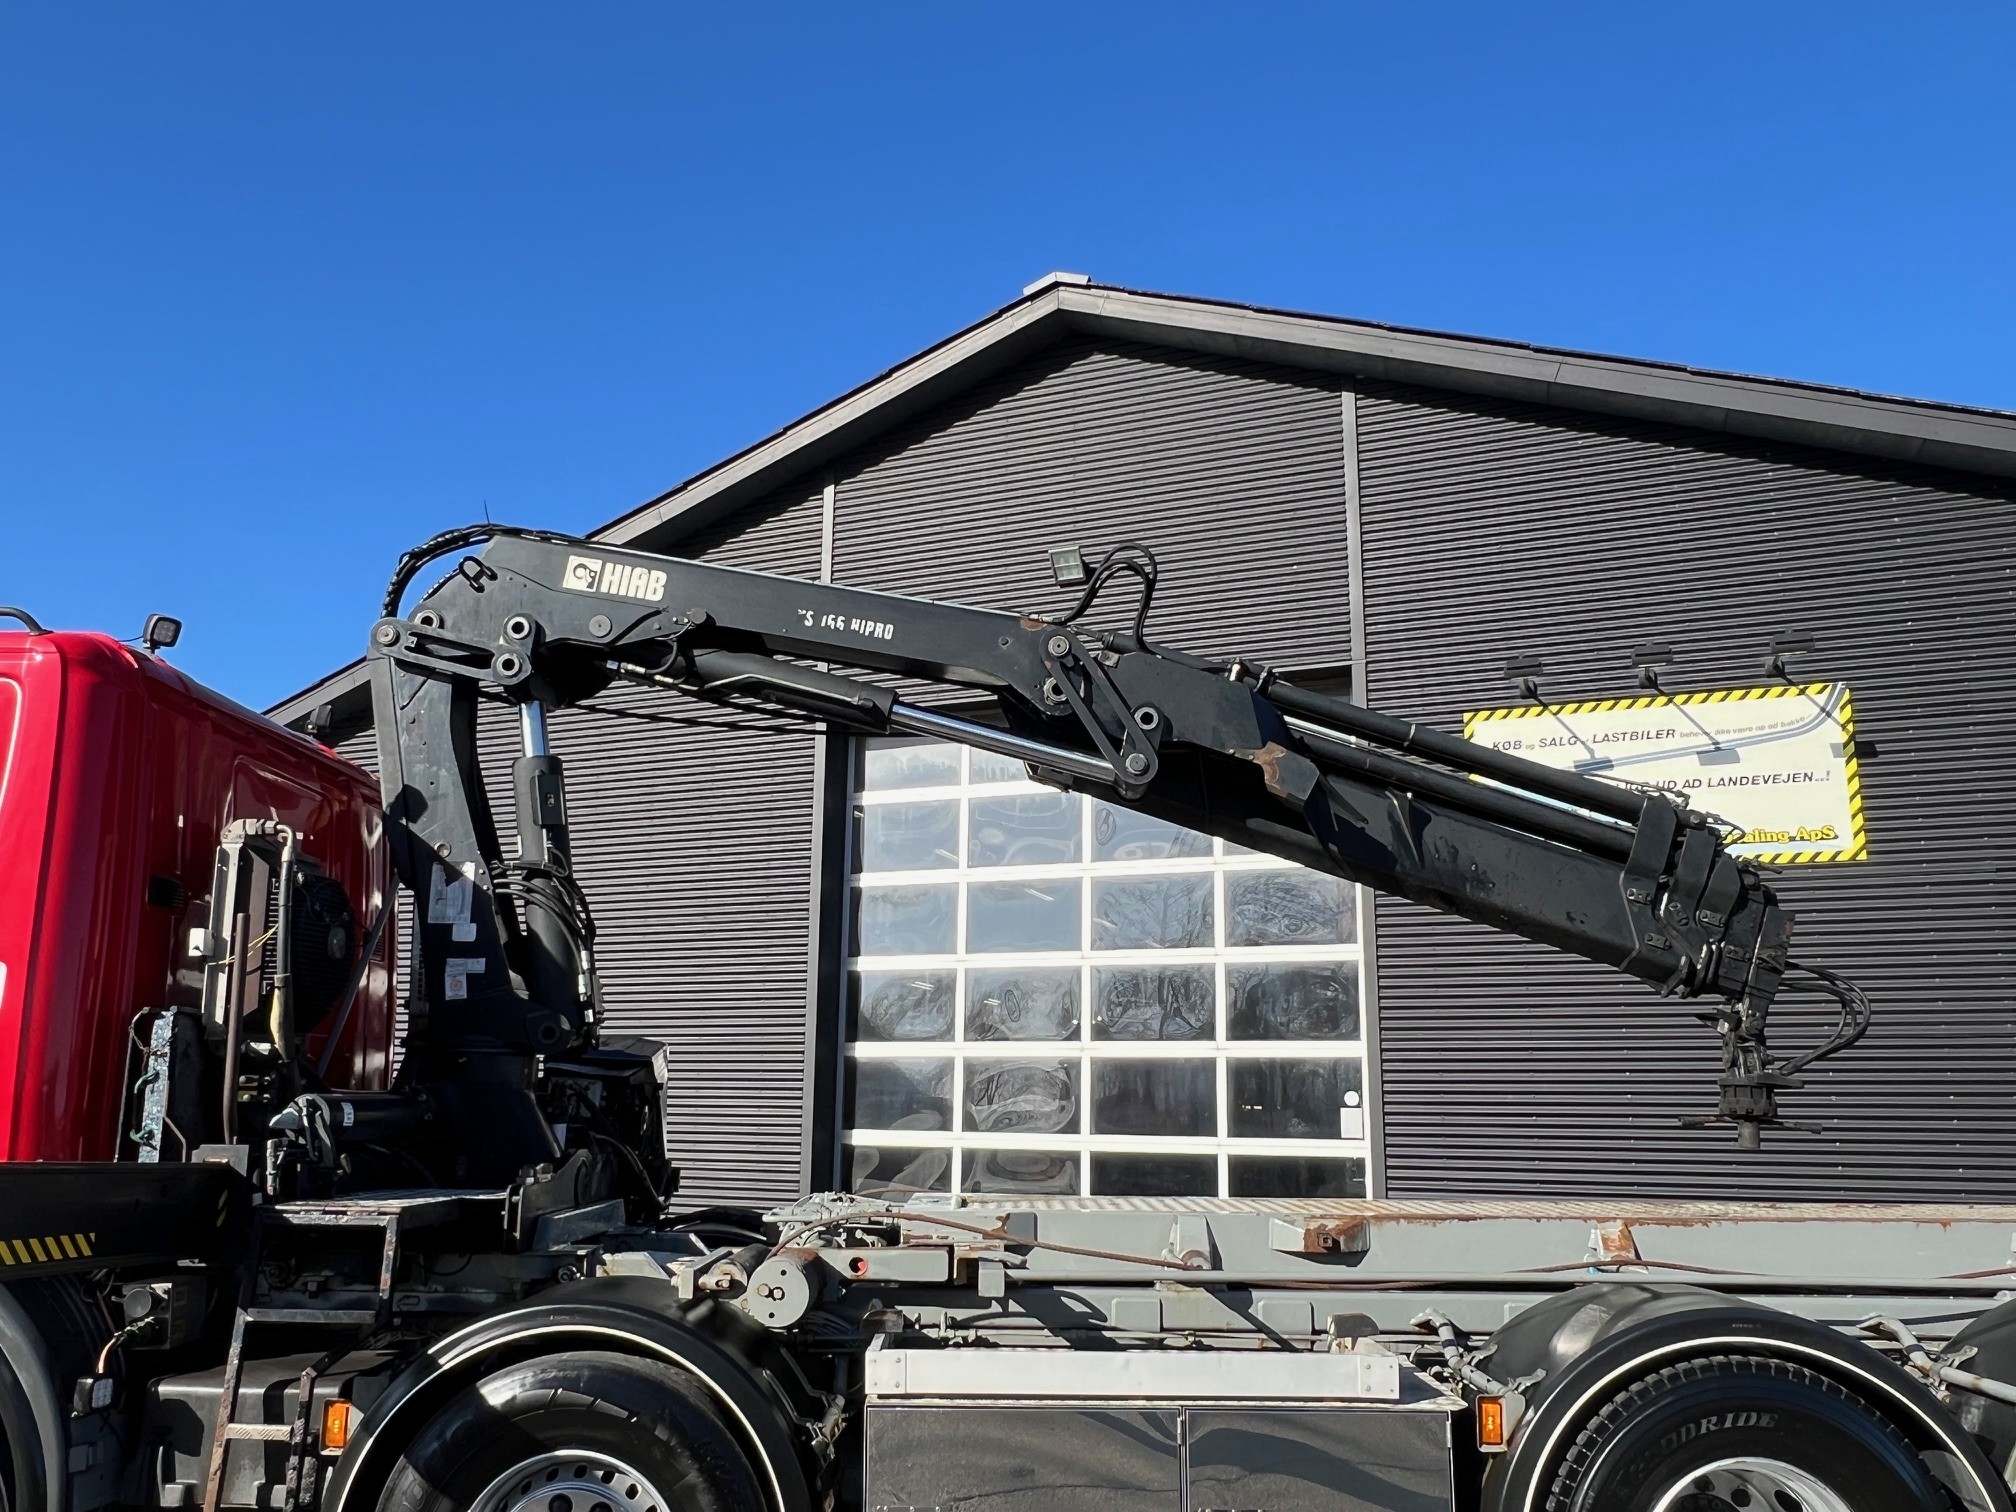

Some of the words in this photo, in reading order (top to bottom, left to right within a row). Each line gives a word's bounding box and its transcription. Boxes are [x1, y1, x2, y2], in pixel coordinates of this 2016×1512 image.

[600, 562, 668, 602] HIAB
[850, 617, 895, 641] HIPRO
[1492, 740, 1523, 751] KØB
[1539, 735, 1579, 748] SALG
[1592, 728, 1677, 744] LASTBILER
[1682, 778, 1703, 790] AD
[1795, 824, 1838, 844] ApS
